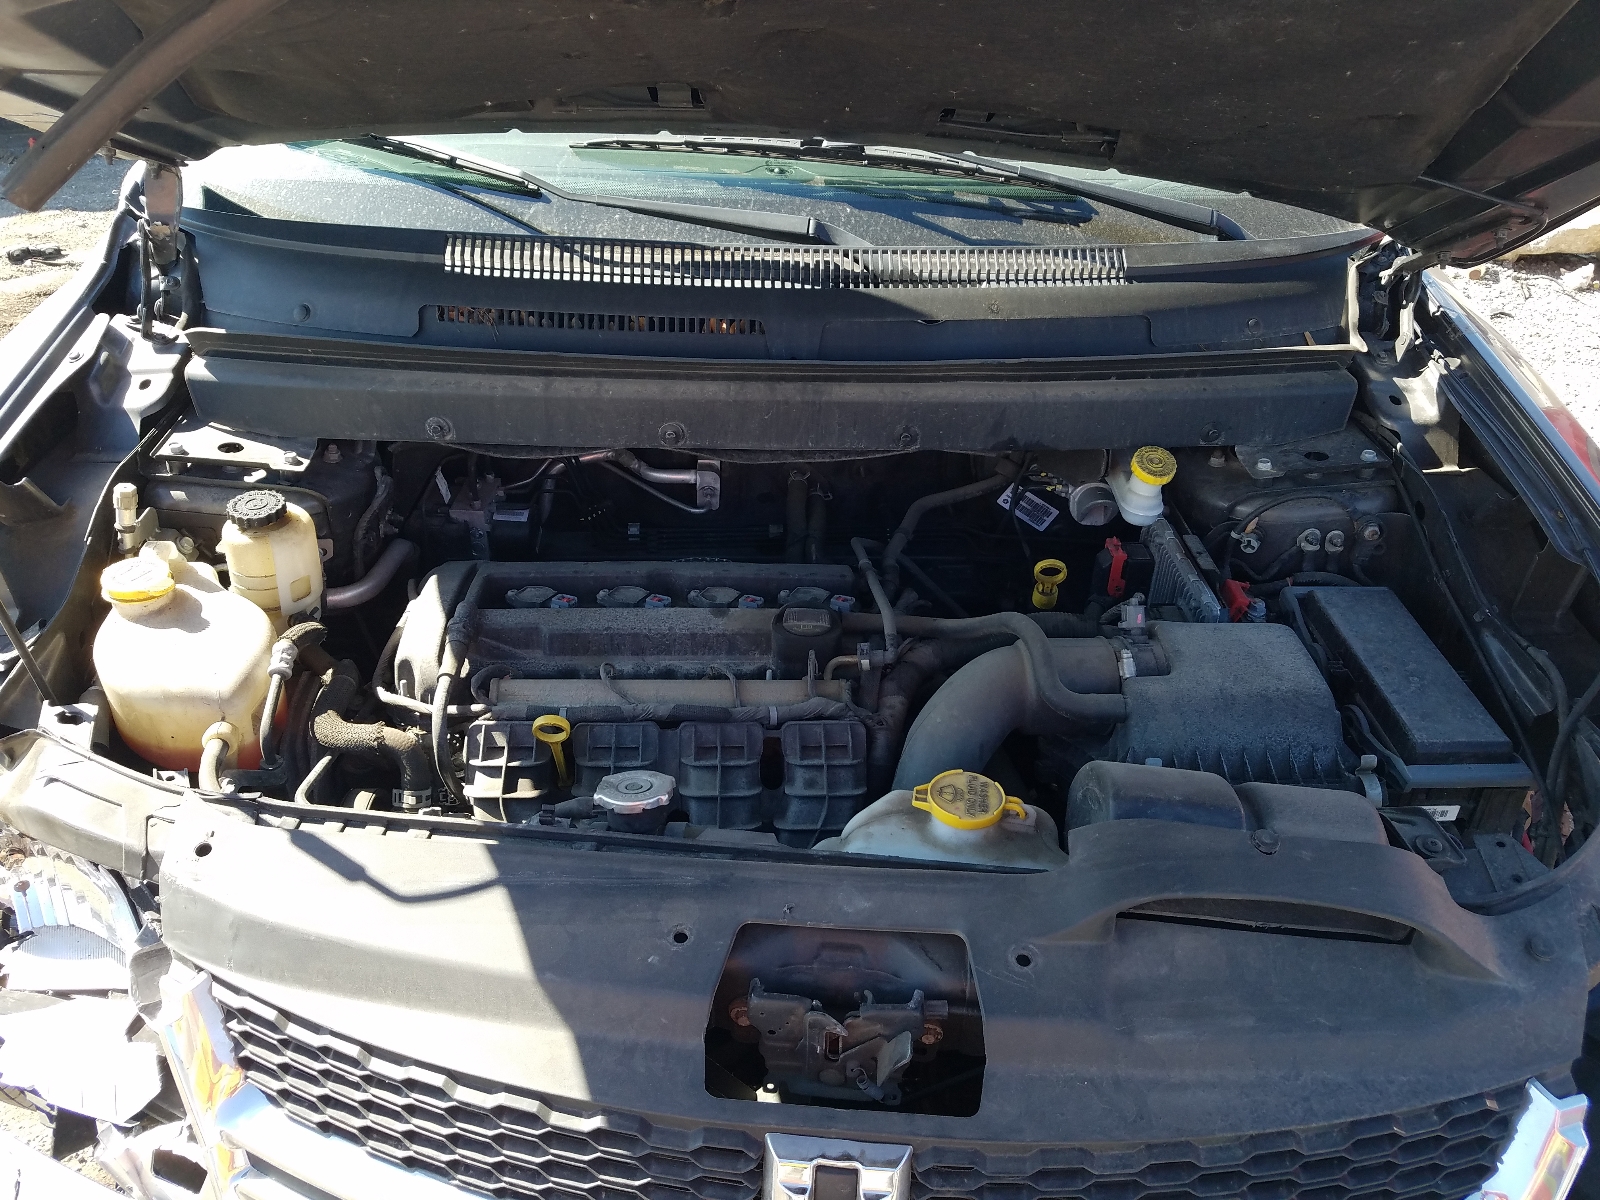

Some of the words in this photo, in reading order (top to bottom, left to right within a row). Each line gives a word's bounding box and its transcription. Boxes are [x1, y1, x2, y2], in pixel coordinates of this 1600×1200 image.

[967, 774, 978, 797] FLUID
[965, 798, 978, 818] ONLY
[978, 781, 989, 814] WASHER
